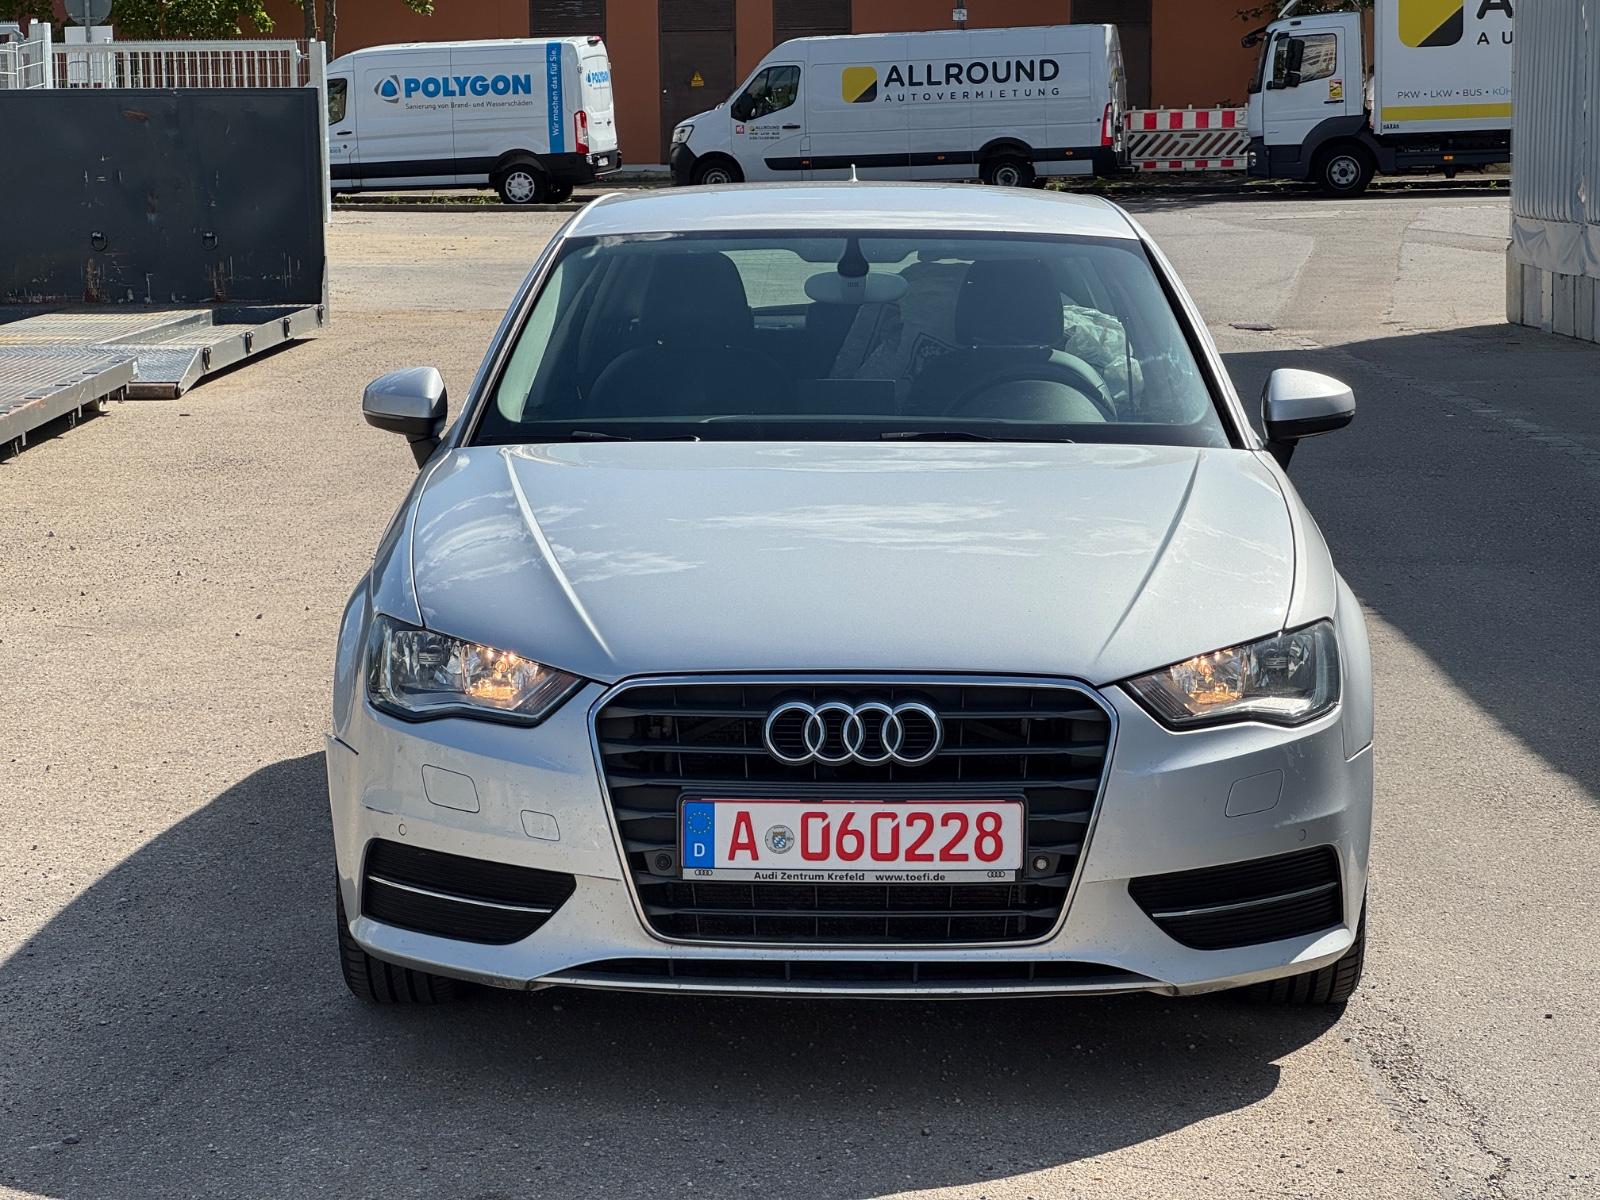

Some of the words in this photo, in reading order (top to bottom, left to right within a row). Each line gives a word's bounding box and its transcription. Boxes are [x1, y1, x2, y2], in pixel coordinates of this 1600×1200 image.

[549, 47, 557, 62] Sie.
[884, 58, 1060, 87] ALLROUND
[404, 74, 532, 98] POLYGON
[1397, 90, 1420, 99] PKW
[1430, 89, 1453, 98] LKW
[1462, 88, 1482, 97] BUS
[884, 87, 1060, 103] AUTOVERMIETUNG
[486, 100, 533, 108] Wasserschäden
[551, 91, 559, 121] machen
[728, 811, 760, 861] A
[800, 811, 1004, 863] 060228
[694, 843, 705, 857] D
[754, 872, 779, 881] Audi
[780, 872, 825, 881] Zentrum
[827, 872, 865, 881] Krefeld
[875, 870, 946, 882] www.toefi.de
